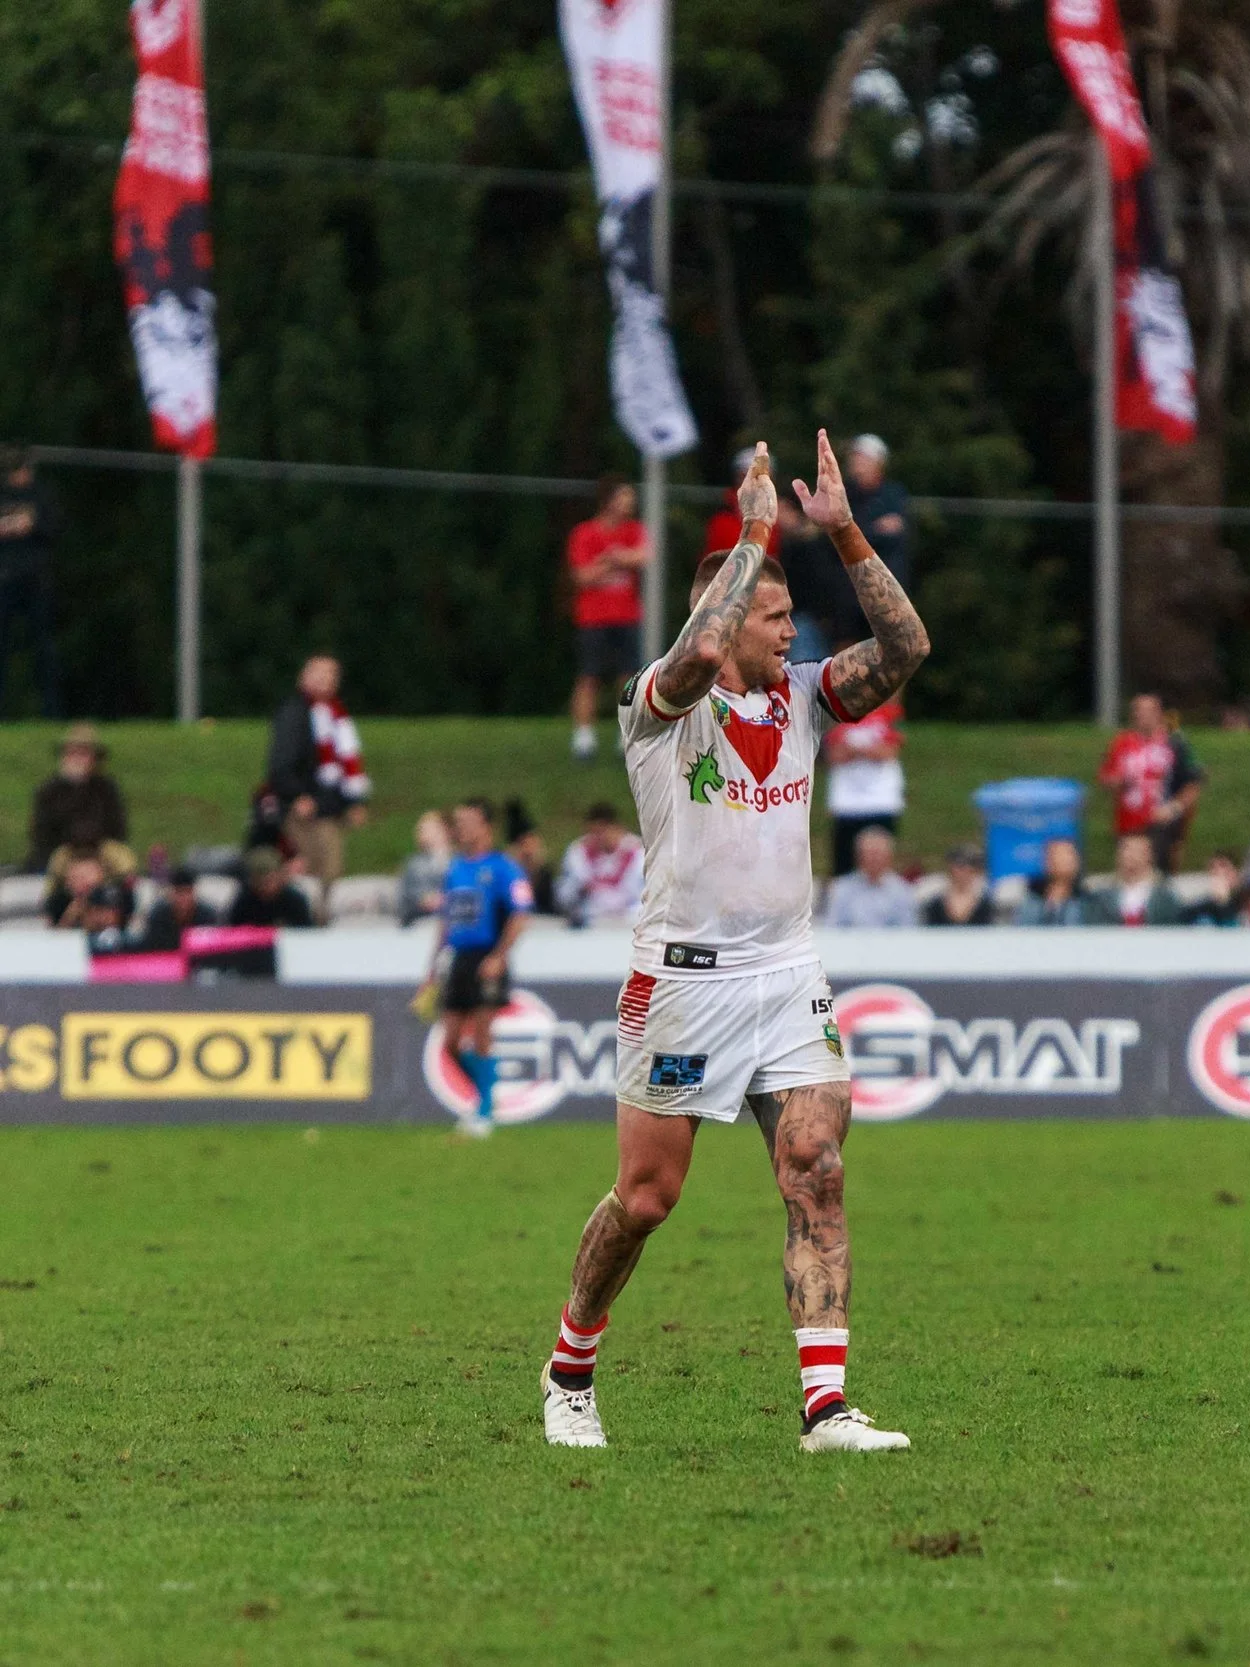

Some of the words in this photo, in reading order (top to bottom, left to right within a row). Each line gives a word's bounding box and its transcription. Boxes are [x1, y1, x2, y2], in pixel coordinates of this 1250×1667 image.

[692, 955, 713, 965] ISC
[0, 1023, 58, 1093] S
[80, 1028, 349, 1083] FOOTY
